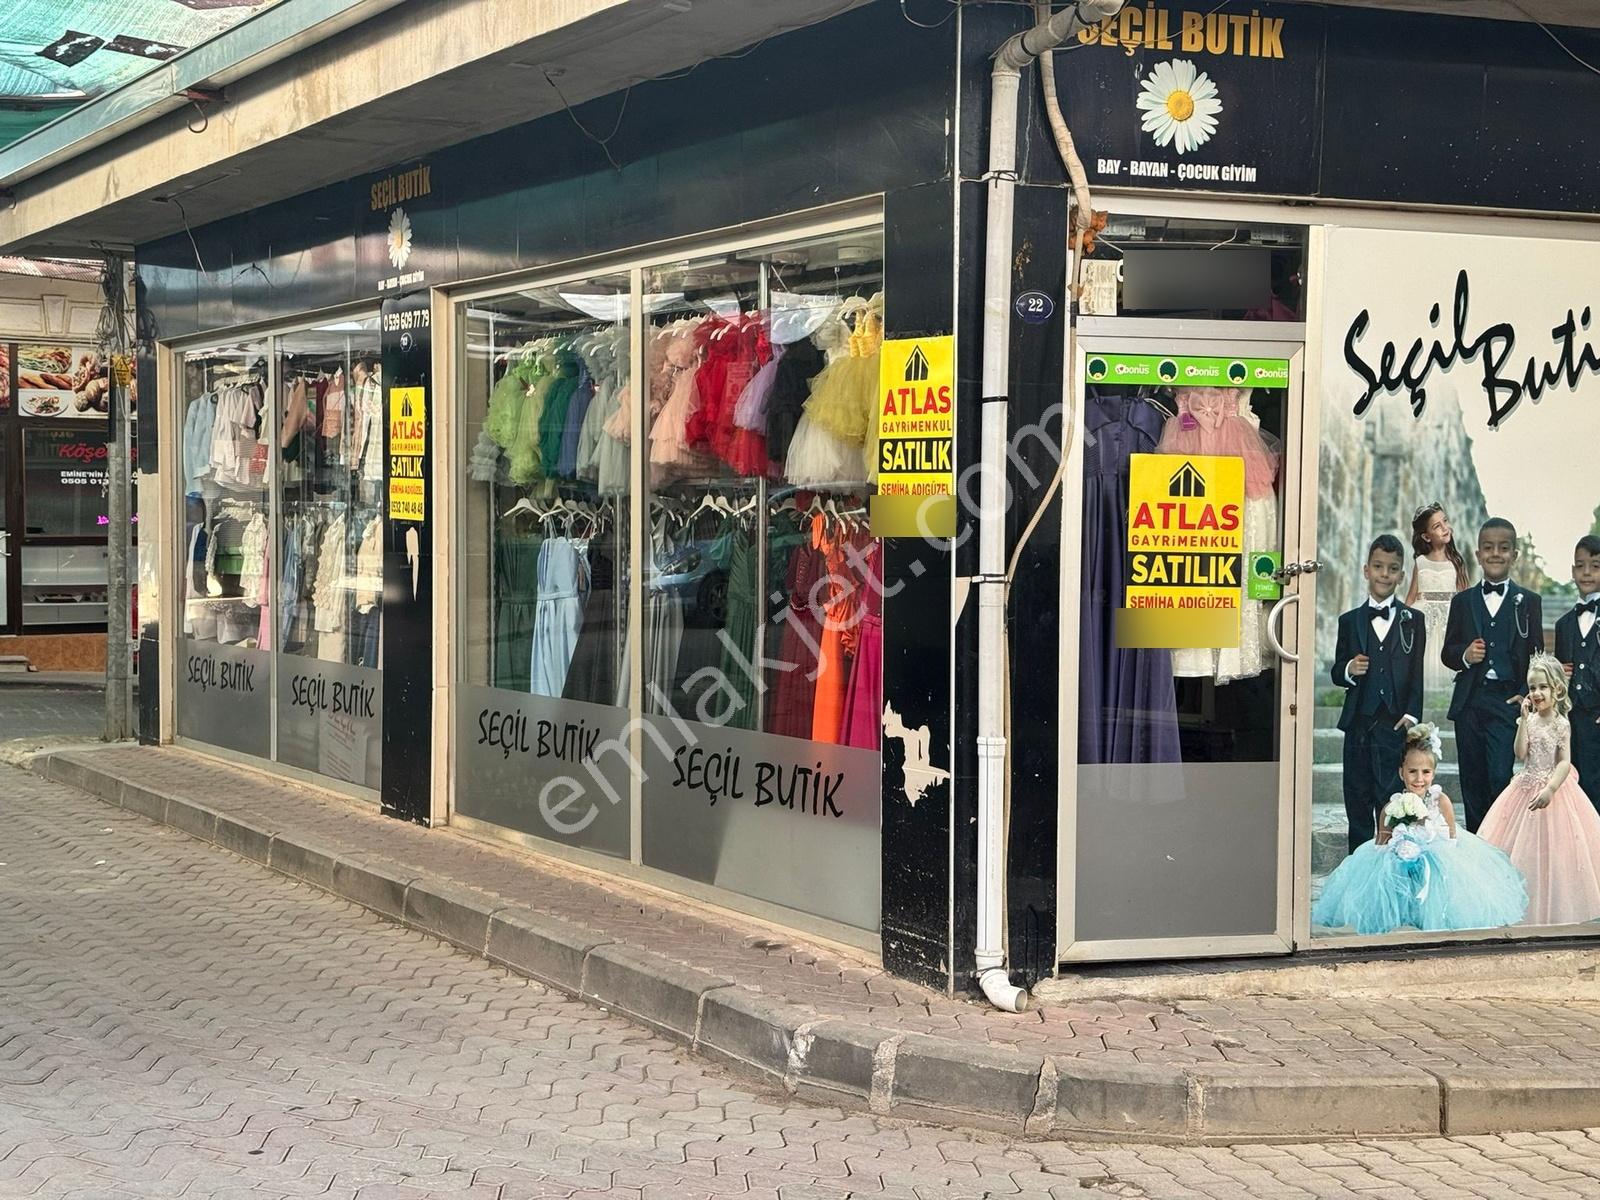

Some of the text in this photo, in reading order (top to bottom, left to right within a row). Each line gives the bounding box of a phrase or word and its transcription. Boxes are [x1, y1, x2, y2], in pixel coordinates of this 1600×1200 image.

[1181, 9, 1285, 59] BUTİK
[1097, 158, 1121, 175] BAY
[1130, 160, 1168, 178] BAYAN
[1177, 163, 1220, 182] ÇOCUK
[1221, 163, 1257, 182] GİYİM
[371, 165, 431, 212] SEÇİL BUTİK
[1028, 297, 1044, 312] 22
[1343, 269, 1600, 432] Seçil Buti
[883, 385, 952, 417] ATLAS
[391, 421, 424, 440] ATLAS
[391, 456, 424, 478] SATILIK
[882, 440, 951, 471] SATILIK
[881, 480, 950, 496] SEMİHA ADIGÜZEL
[1132, 502, 1240, 531] ATLAS
[1131, 554, 1237, 585] SATILIK
[1130, 593, 1174, 609] SEMİHA
[1178, 593, 1237, 609] ADIGÜZEL
[188, 654, 255, 693] SEÇİL BUTİK
[291, 672, 375, 719] SEÇİL BUTİK
[478, 708, 600, 766] SEÇİL BUTİK
[672, 743, 844, 819] SEÇİL BUTİK
